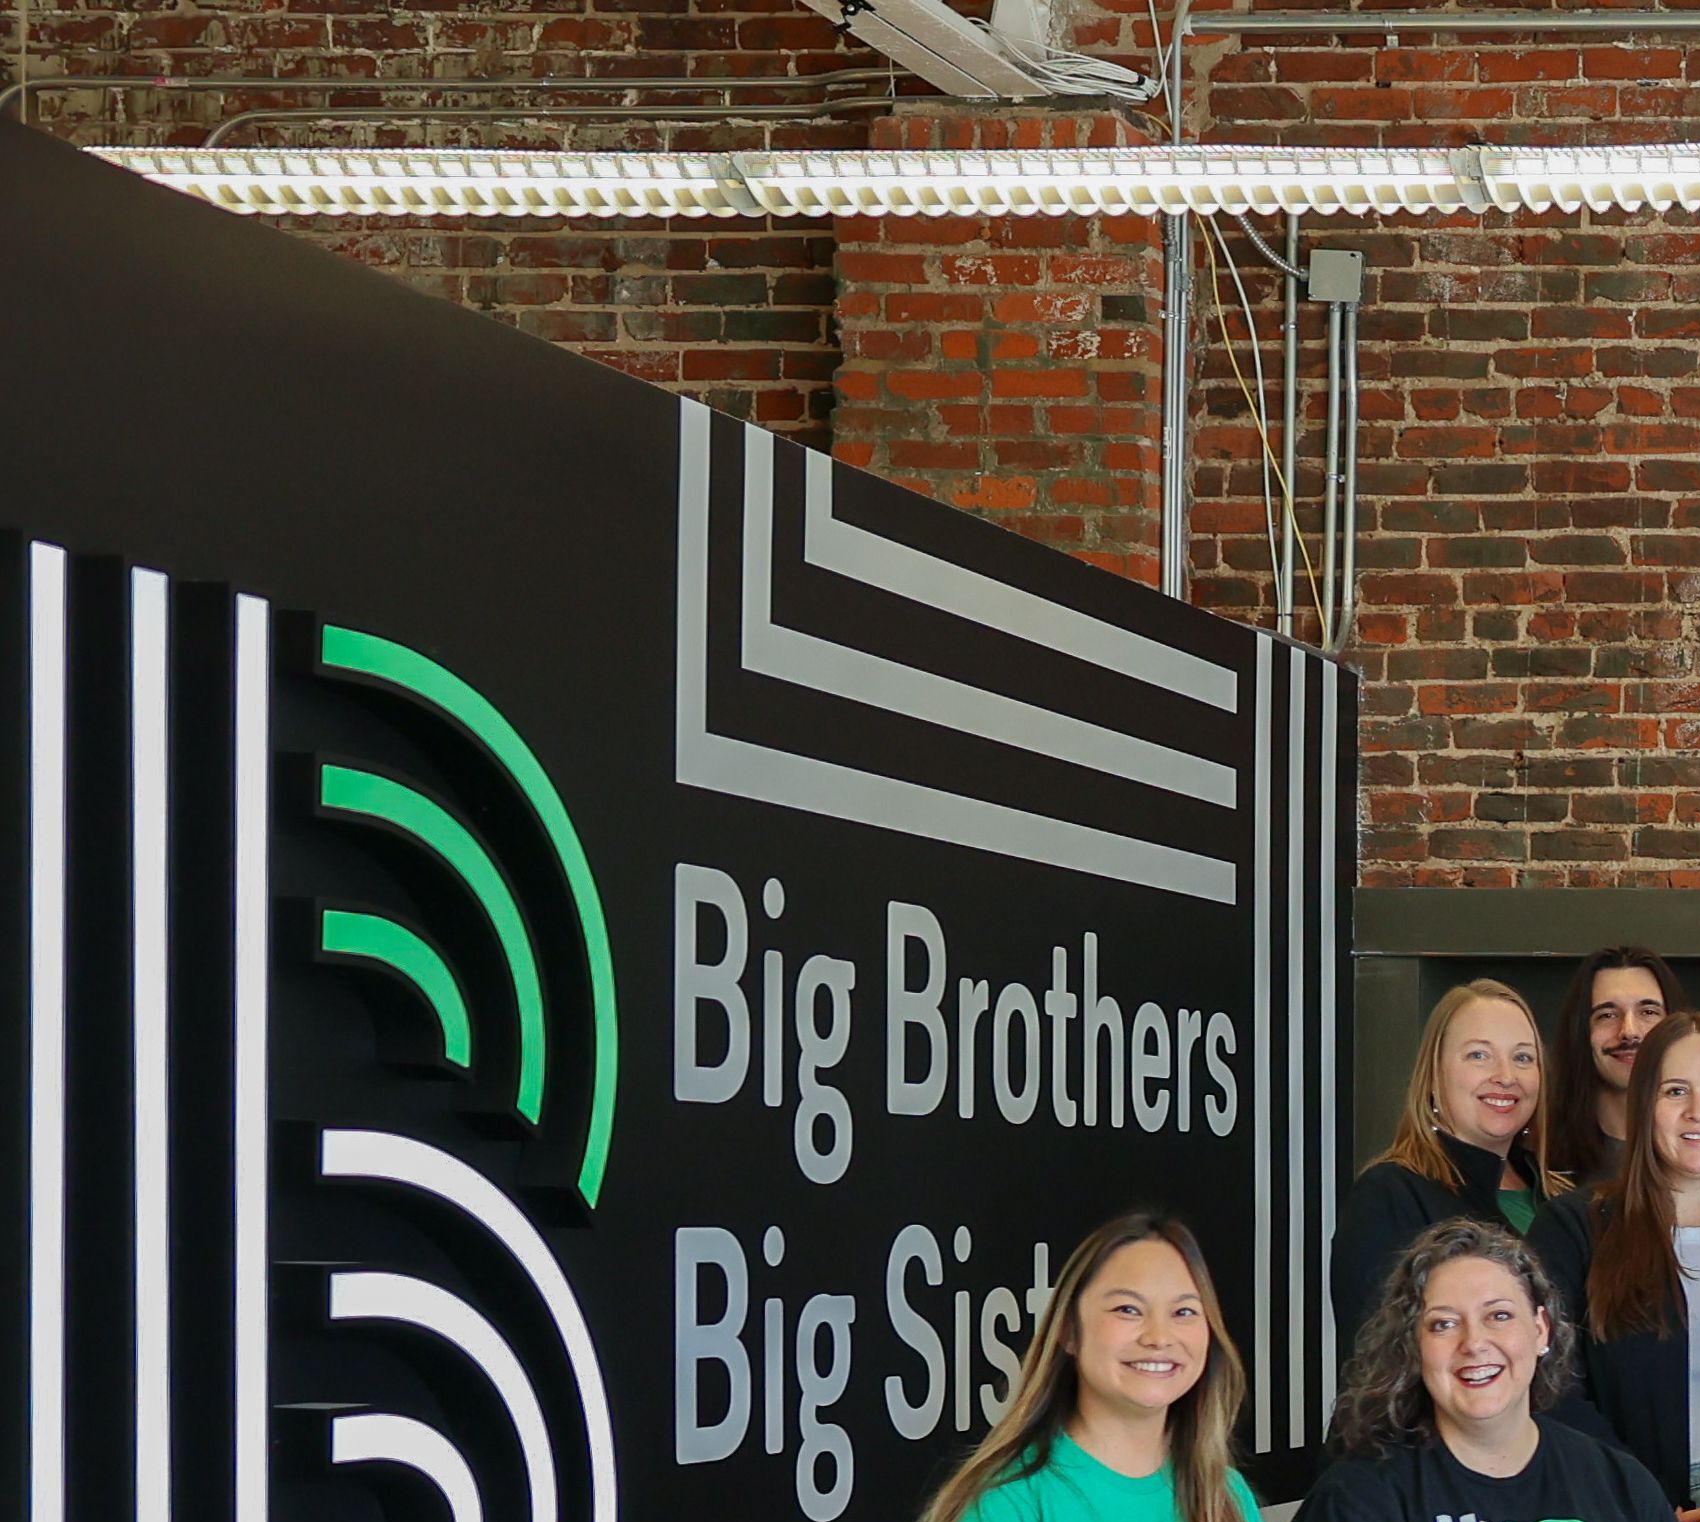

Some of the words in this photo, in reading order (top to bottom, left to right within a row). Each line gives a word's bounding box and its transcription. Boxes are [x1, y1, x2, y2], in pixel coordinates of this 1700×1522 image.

[675, 863, 855, 1184] Big
[887, 901, 1238, 1137] Brothers
[675, 1226, 855, 1522] Big
[885, 1225, 1058, 1440] Sist
